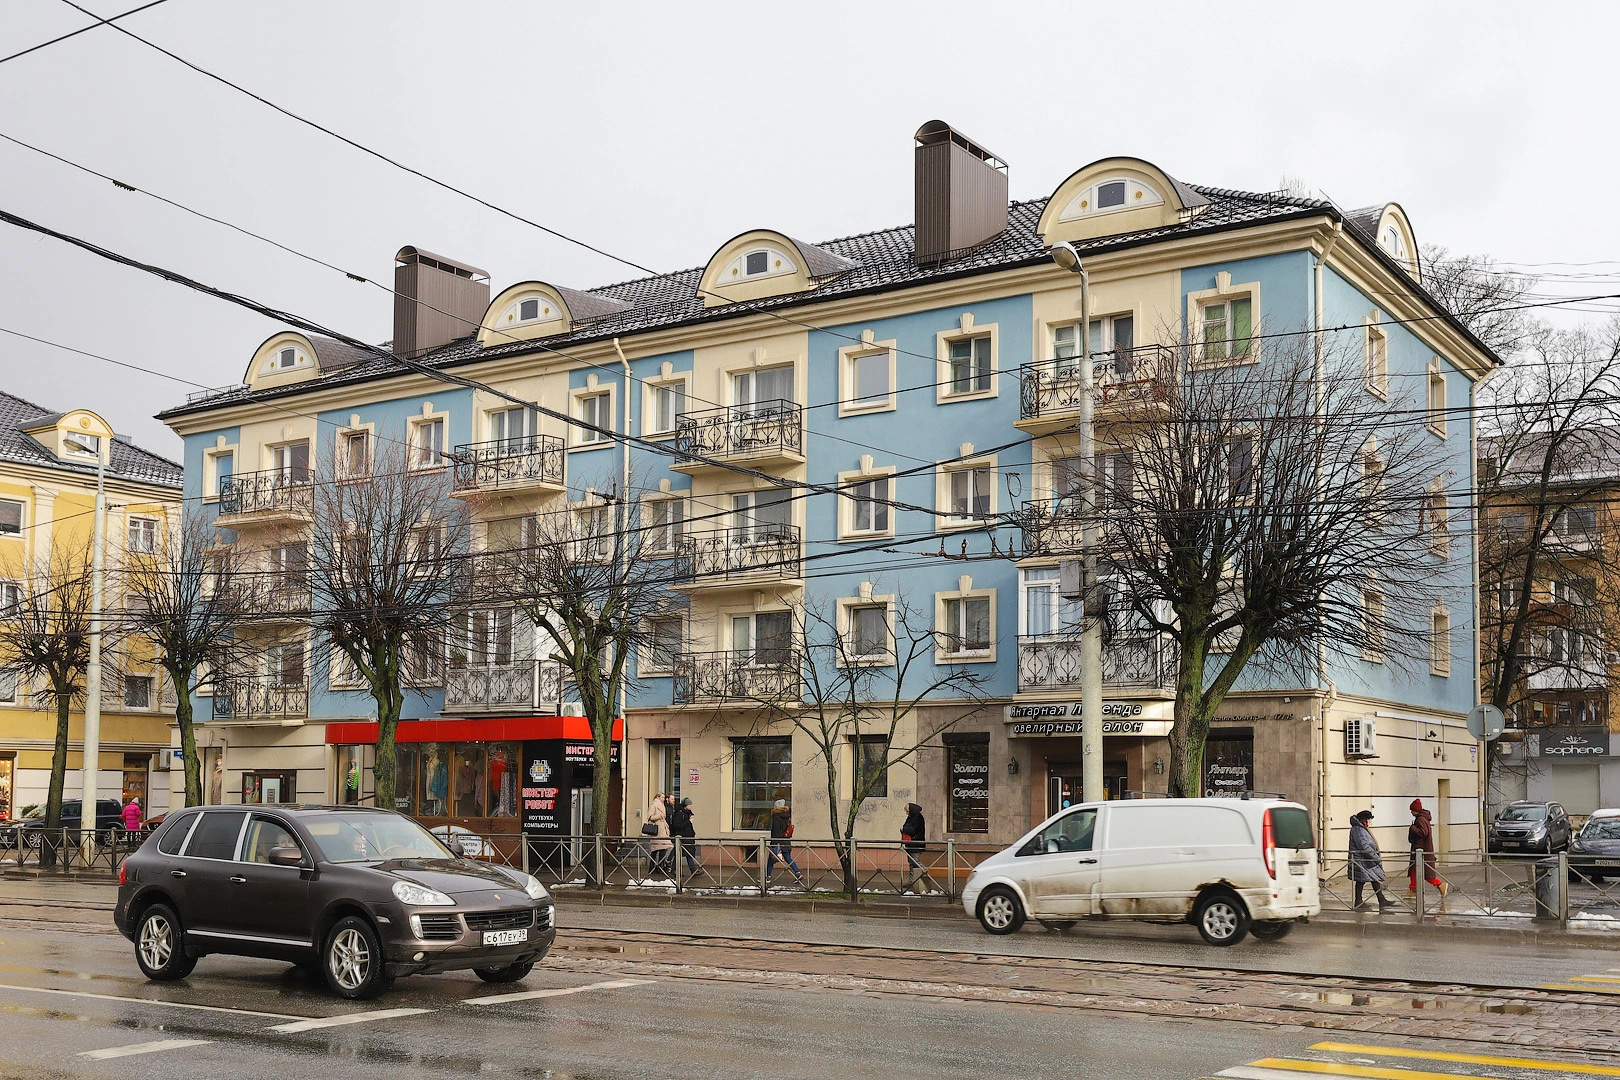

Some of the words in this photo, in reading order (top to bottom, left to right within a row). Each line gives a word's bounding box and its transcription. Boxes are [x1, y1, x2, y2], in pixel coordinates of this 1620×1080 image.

[1010, 705, 1067, 719] Янтарная
[1071, 702, 1142, 717] Ленда
[1102, 721, 1143, 732] алон
[565, 745, 594, 755] МИСТЕР
[1545, 745, 1604, 756] sophene
[953, 763, 988, 774] Золото
[1208, 764, 1249, 776] Янтарь
[522, 787, 558, 798] МИСТЕР
[953, 787, 989, 799] Серебро
[525, 799, 555, 810] РОБОТ
